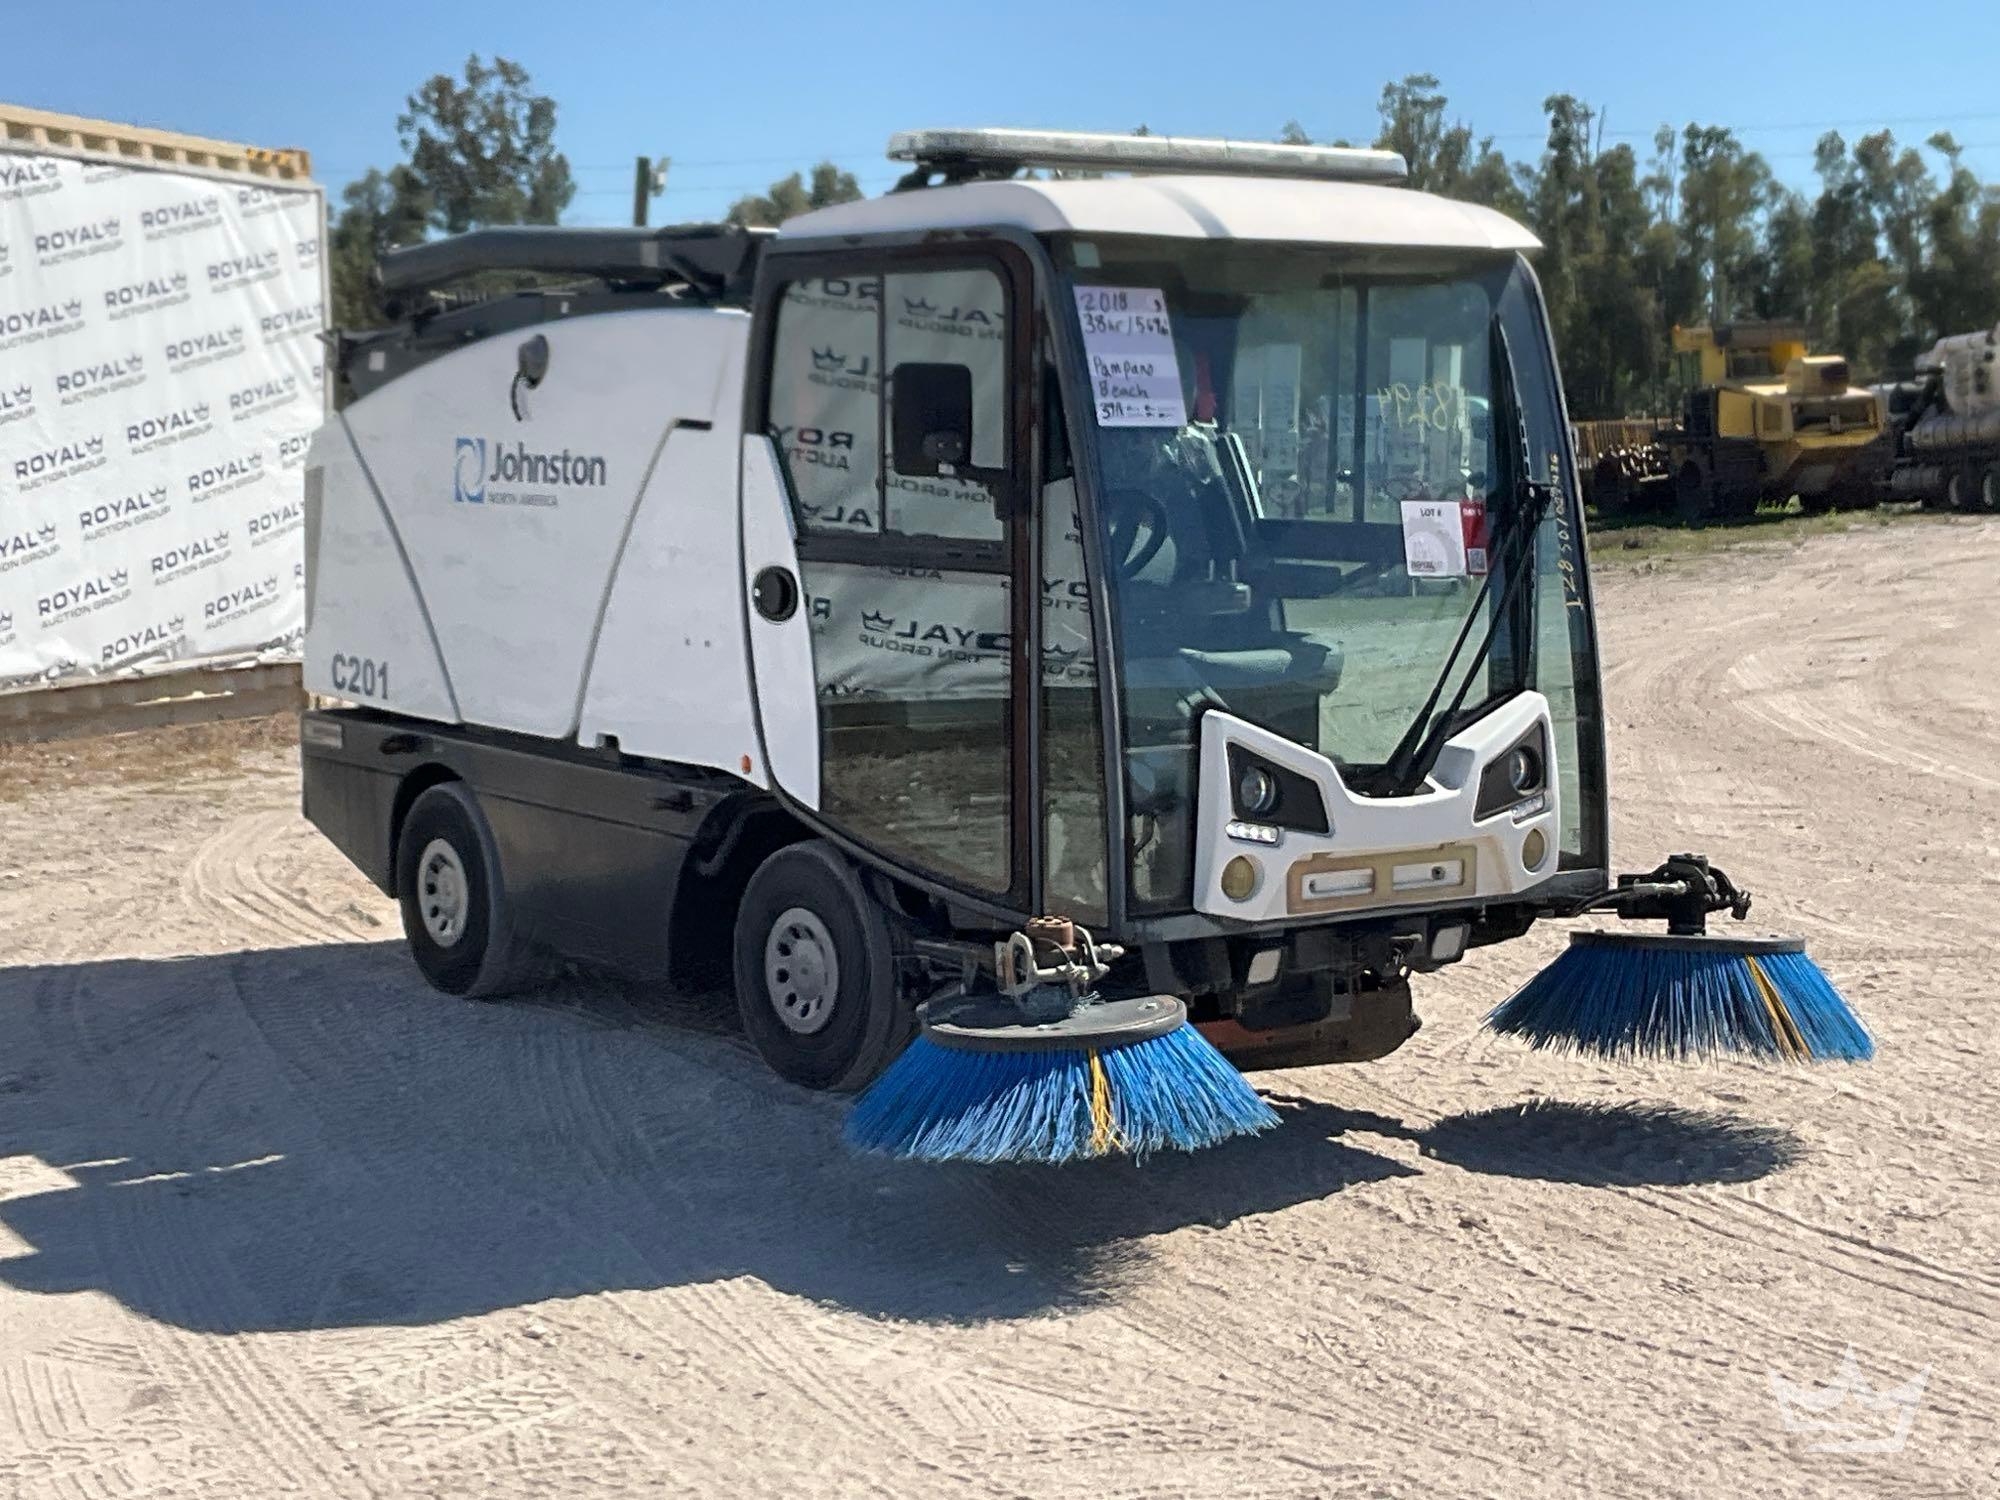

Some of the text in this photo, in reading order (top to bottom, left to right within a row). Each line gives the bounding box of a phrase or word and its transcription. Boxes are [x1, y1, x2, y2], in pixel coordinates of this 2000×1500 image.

[141, 200, 205, 227] ROYAL
[35, 223, 104, 252] ROYAL
[207, 253, 265, 279] ROYAL
[104, 278, 171, 307] ROYAL
[1080, 292, 1128, 313] 2018
[260, 306, 314, 332] ROYAL
[165, 331, 229, 361] ROYAL
[56, 360, 126, 393] ROYAL
[1098, 379, 1149, 399] Beach
[229, 379, 284, 410] ROYAL
[127, 408, 194, 442] ROYAL
[15, 443, 86, 479] ROYAL
[188, 457, 249, 492] ROYAL
[490, 441, 606, 486] Johnston
[80, 494, 150, 529] ROYAL
[249, 503, 299, 535] ROYAL
[1420, 508, 1435, 517] LOT
[152, 538, 214, 573] ROYAL
[38, 578, 110, 617] ROYAL
[205, 583, 264, 619] ROYAL
[102, 624, 168, 662] ROYAL
[332, 653, 388, 700] C201
